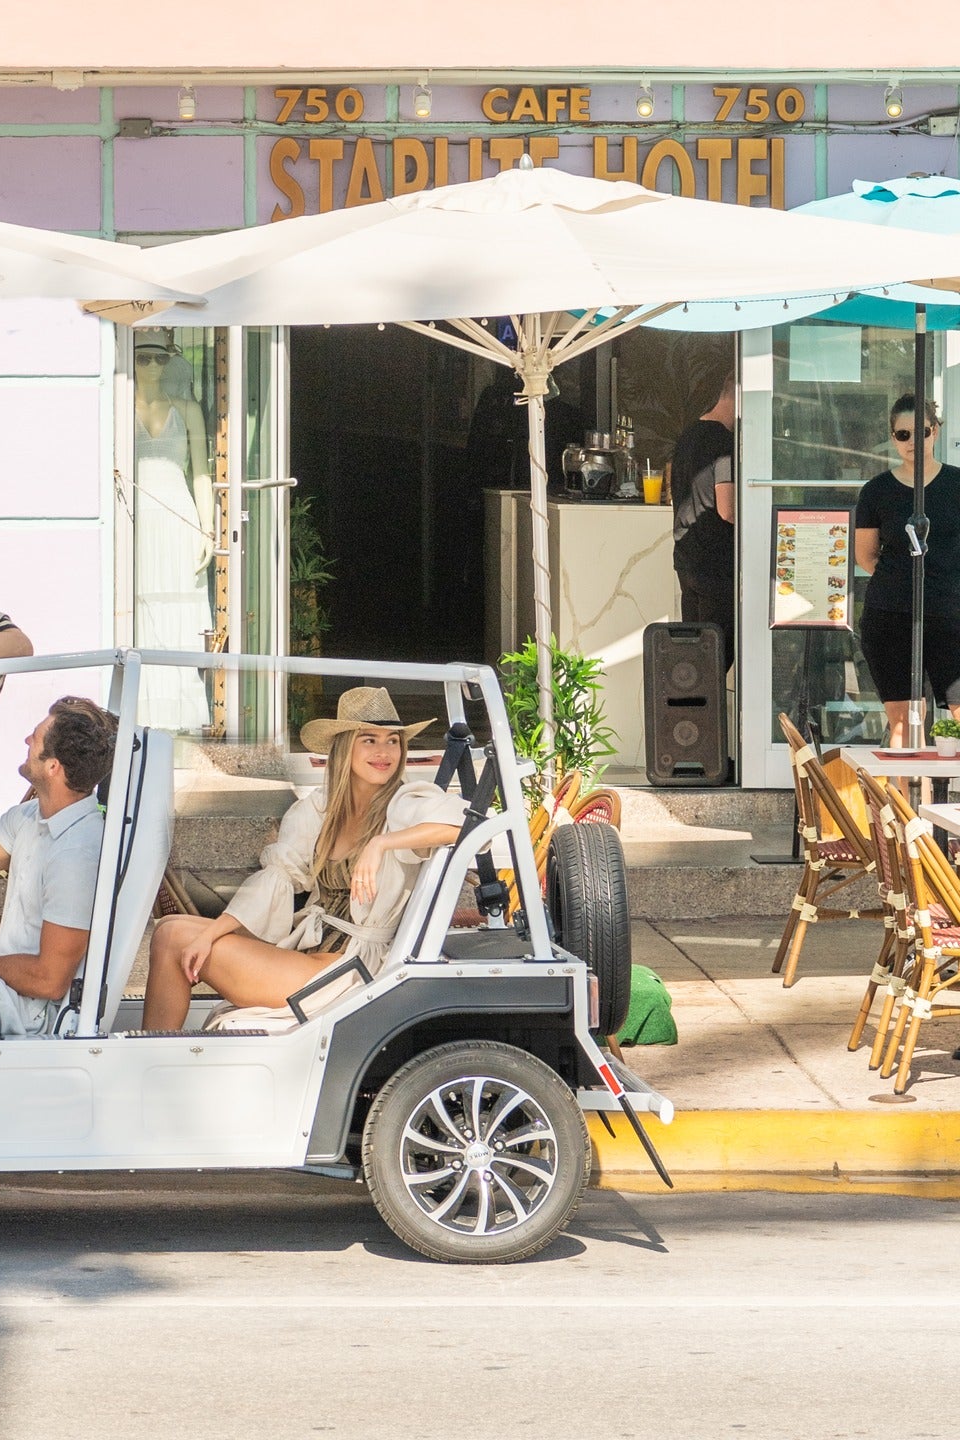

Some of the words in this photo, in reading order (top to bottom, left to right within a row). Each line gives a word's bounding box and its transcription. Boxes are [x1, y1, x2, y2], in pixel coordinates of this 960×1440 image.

[274, 87, 365, 123] 750
[481, 87, 592, 123] CAFE
[712, 87, 806, 122] 750
